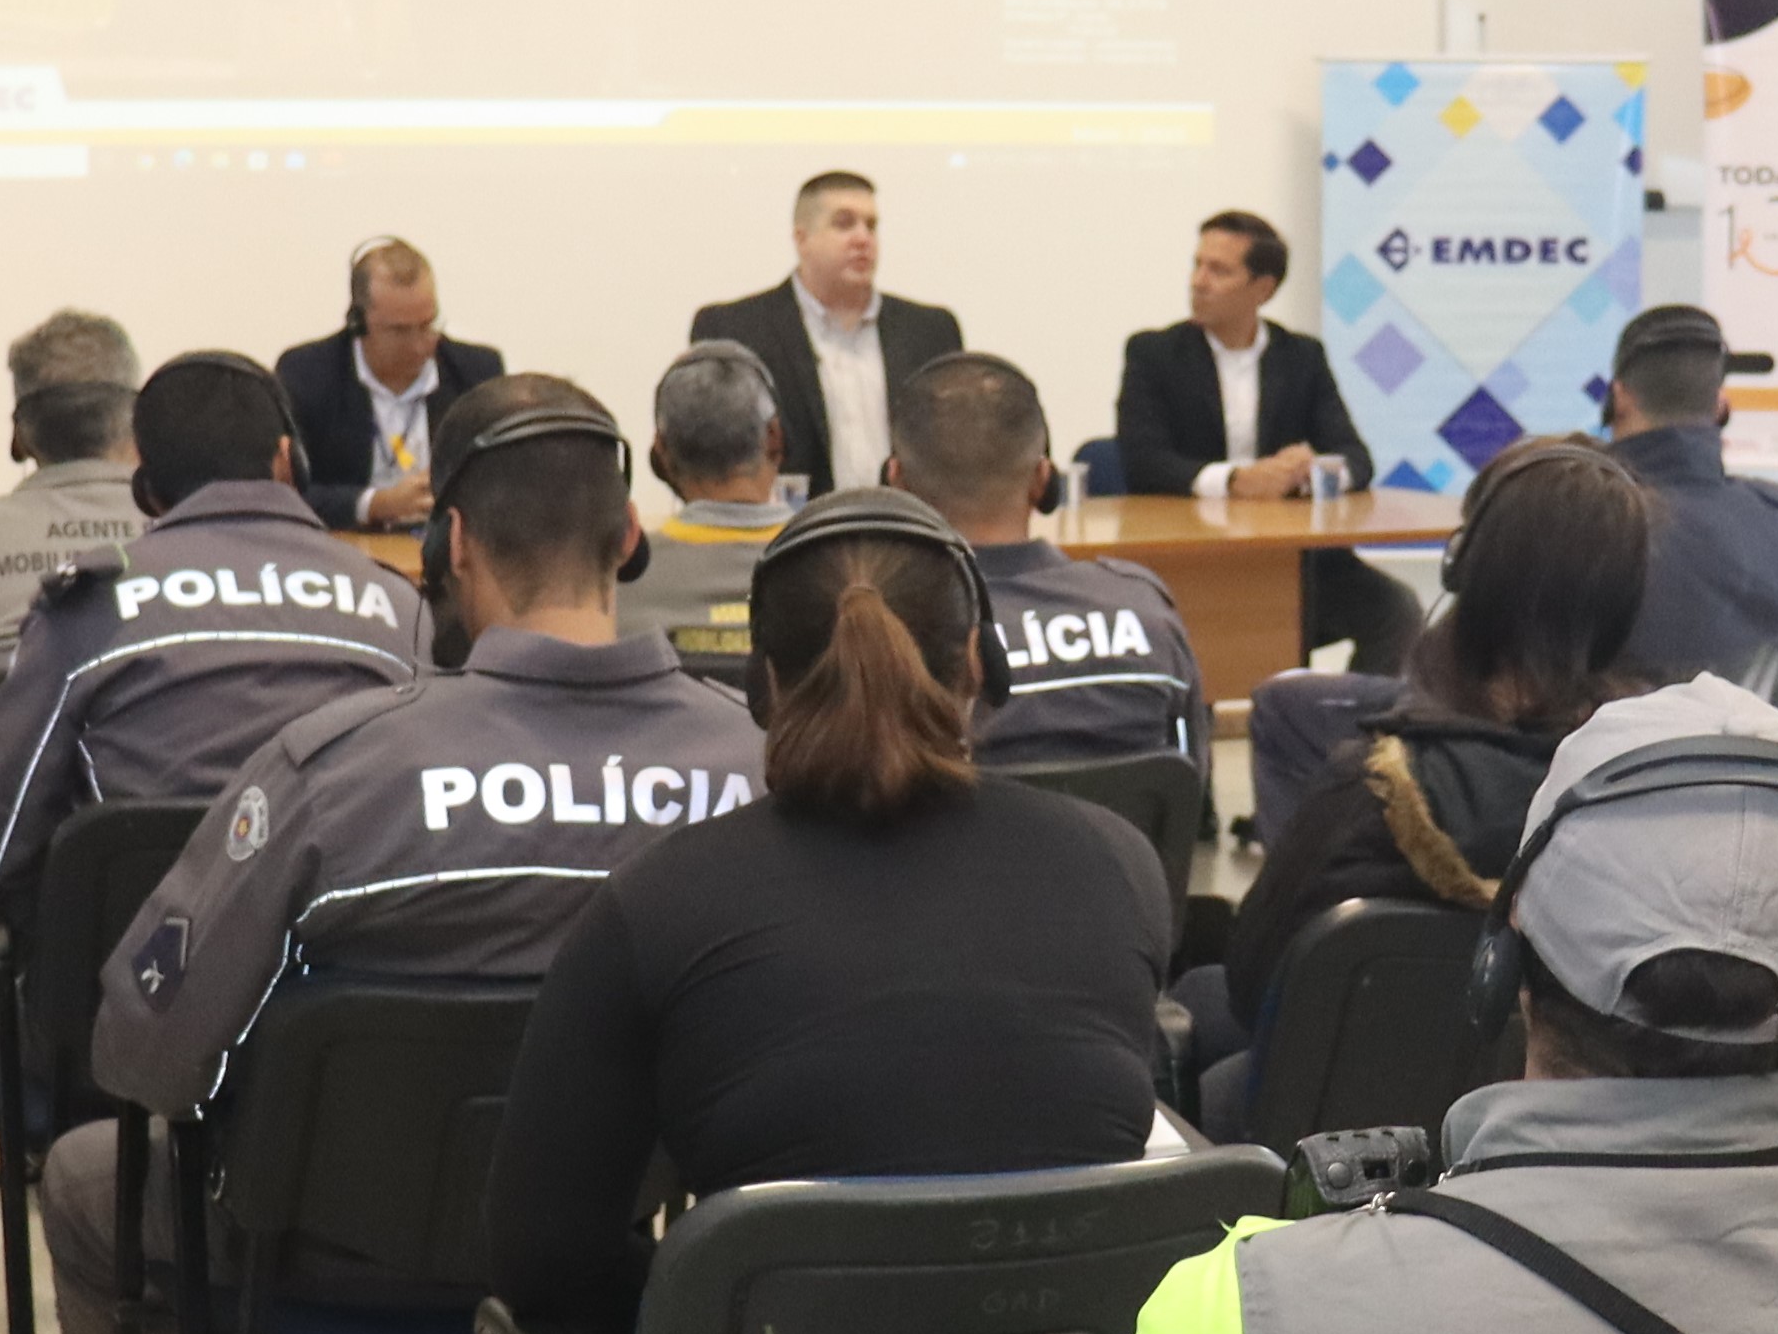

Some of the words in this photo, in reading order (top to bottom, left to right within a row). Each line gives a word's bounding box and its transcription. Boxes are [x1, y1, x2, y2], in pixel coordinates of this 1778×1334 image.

[1432, 237, 1588, 265] EMDEC
[47, 520, 134, 539] AGENTE
[115, 562, 400, 629] POLÍCIA
[994, 609, 1153, 668] LÍCIA
[421, 755, 754, 831] POLÍCIA
